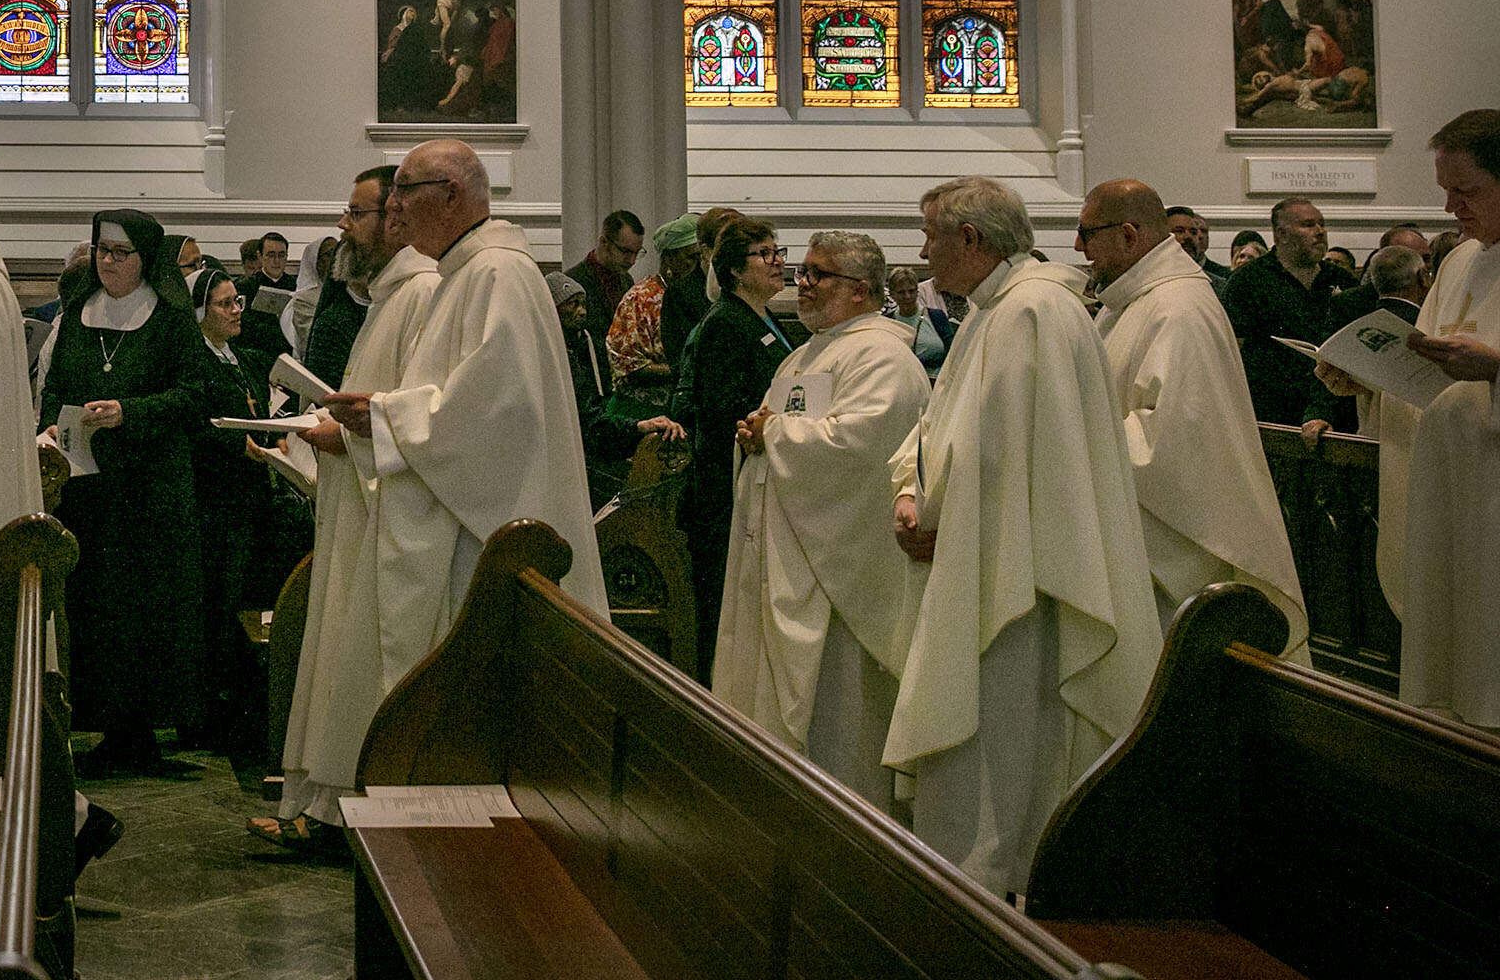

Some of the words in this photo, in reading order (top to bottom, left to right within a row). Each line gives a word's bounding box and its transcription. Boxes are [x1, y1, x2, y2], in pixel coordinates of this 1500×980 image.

[1307, 164, 1317, 172] XI
[1271, 171, 1295, 180] JESUS
[1289, 179, 1306, 187] THE
[1308, 179, 1337, 188] CROSS
